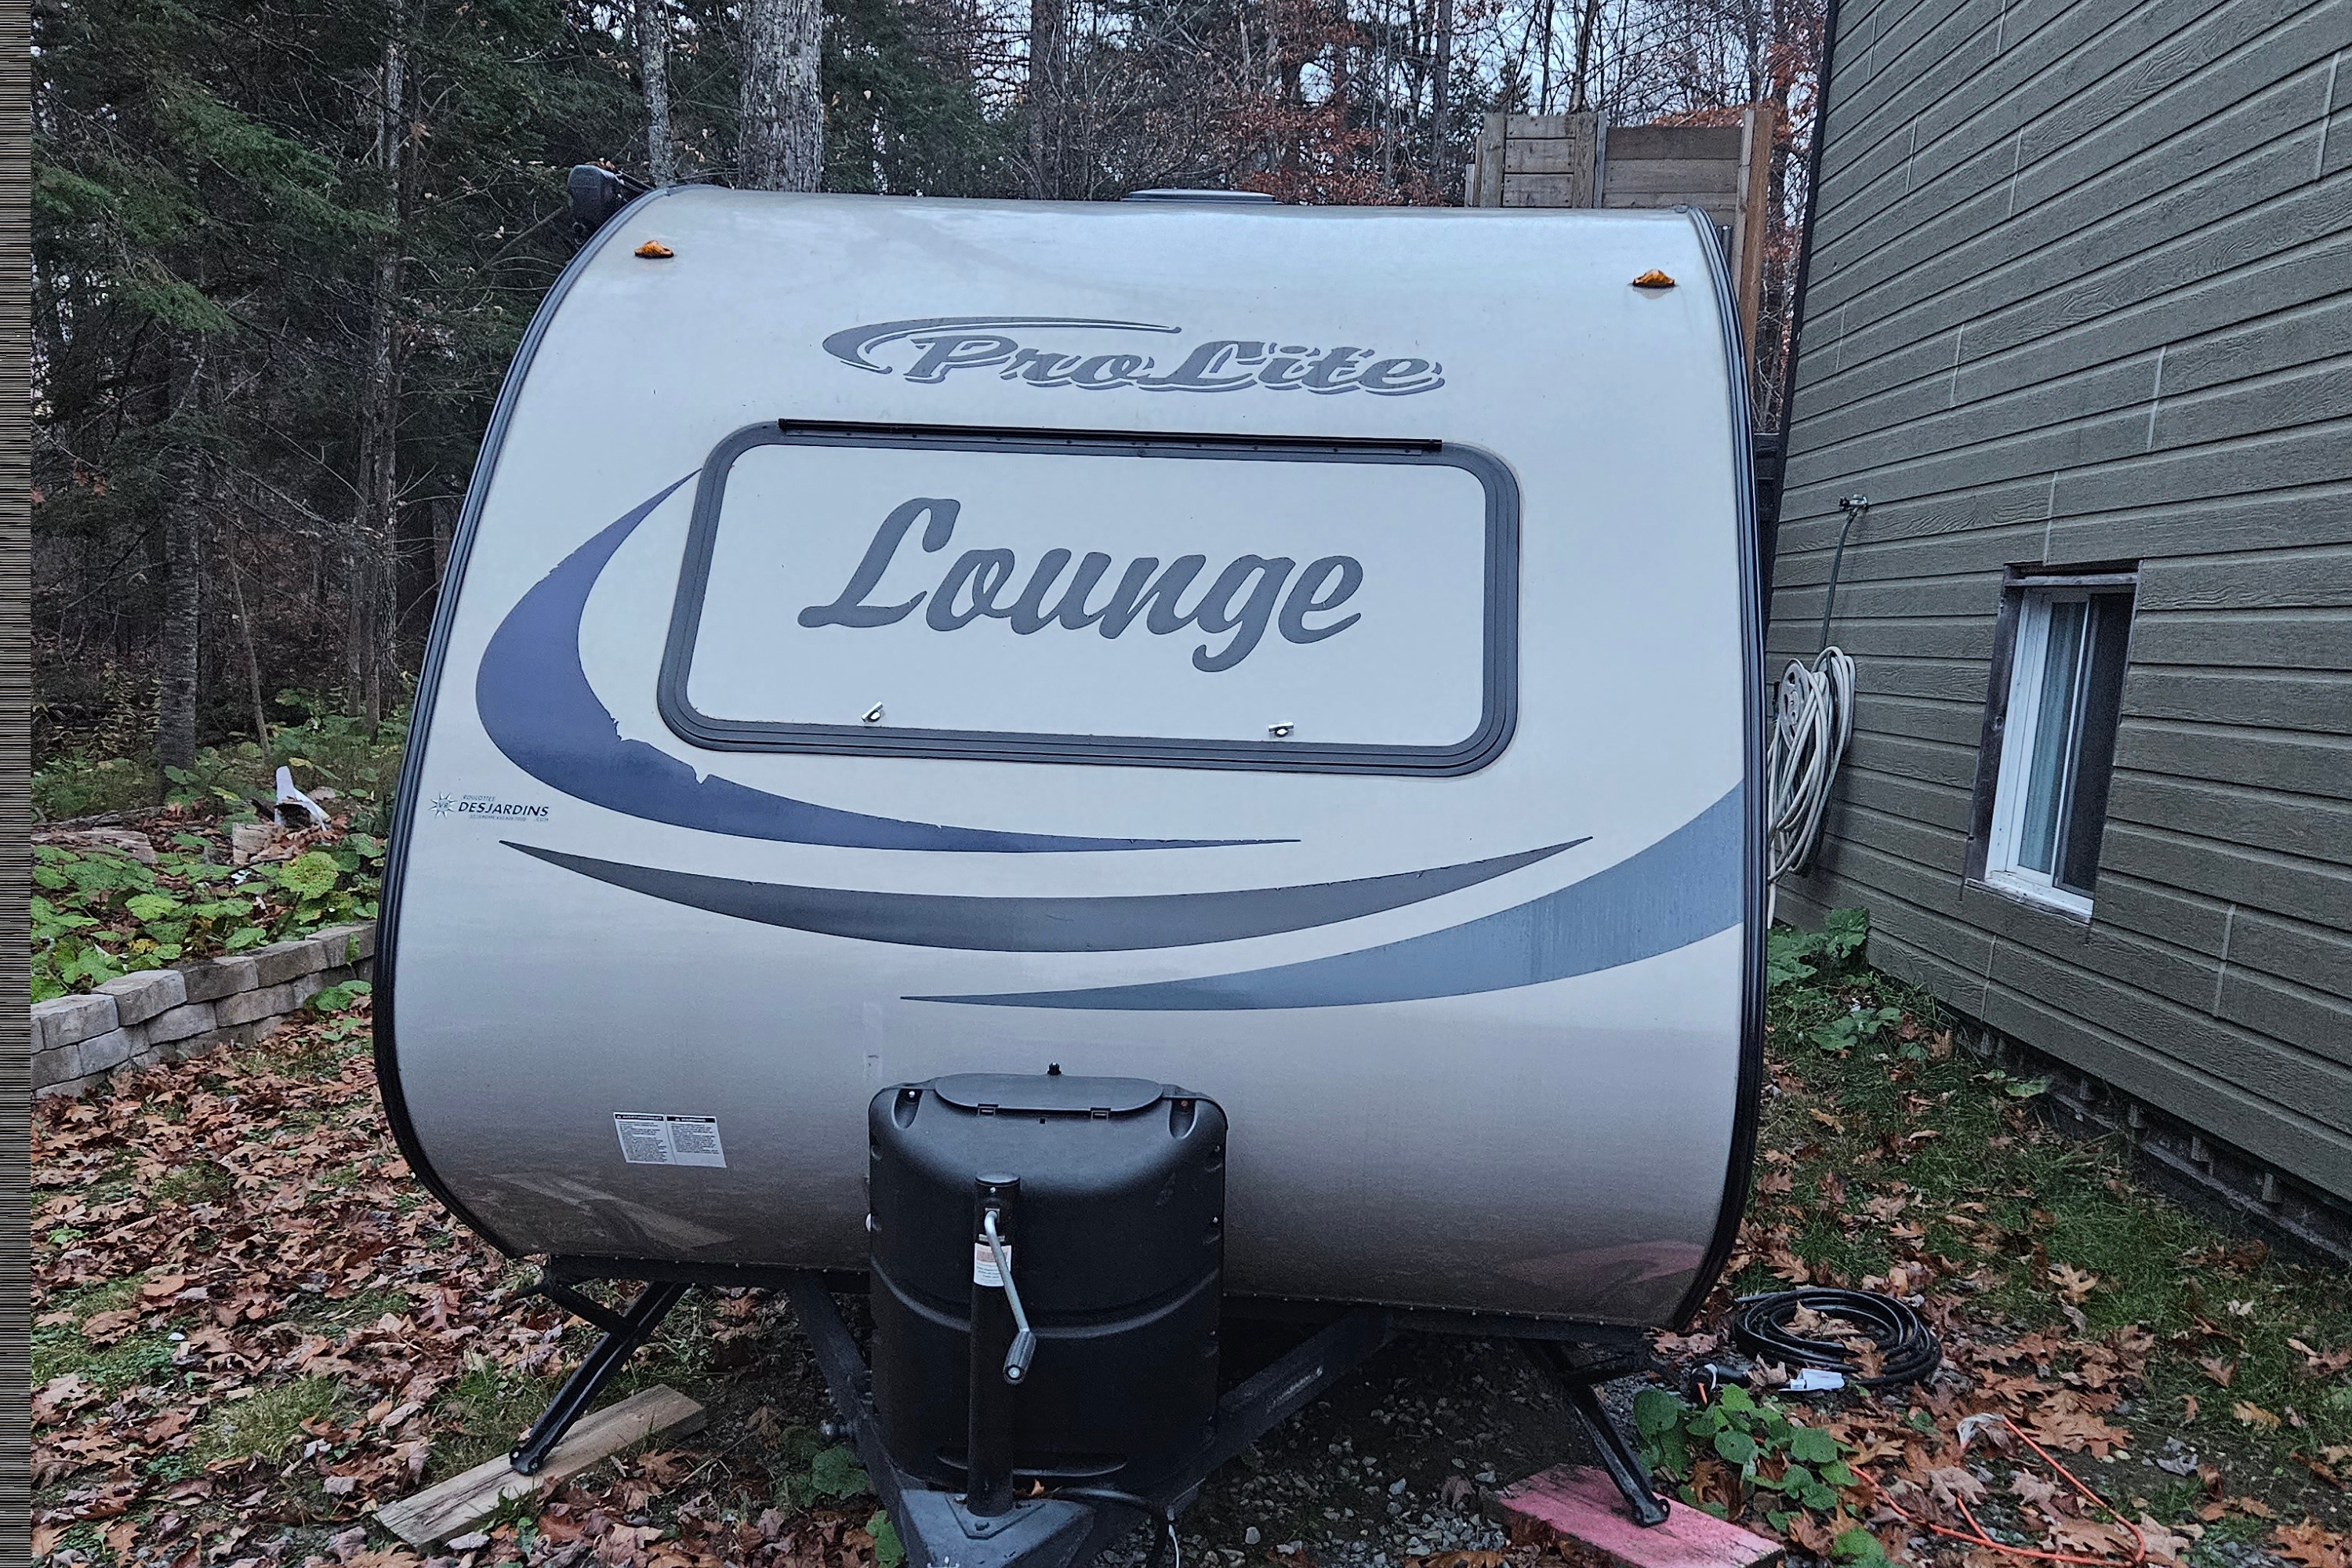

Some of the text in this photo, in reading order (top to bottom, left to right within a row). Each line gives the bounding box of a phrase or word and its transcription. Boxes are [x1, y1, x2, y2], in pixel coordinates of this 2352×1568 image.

[902, 334, 1444, 396] ProLite
[797, 497, 1364, 673] Lounge
[458, 801, 549, 817] DESJARDINS
